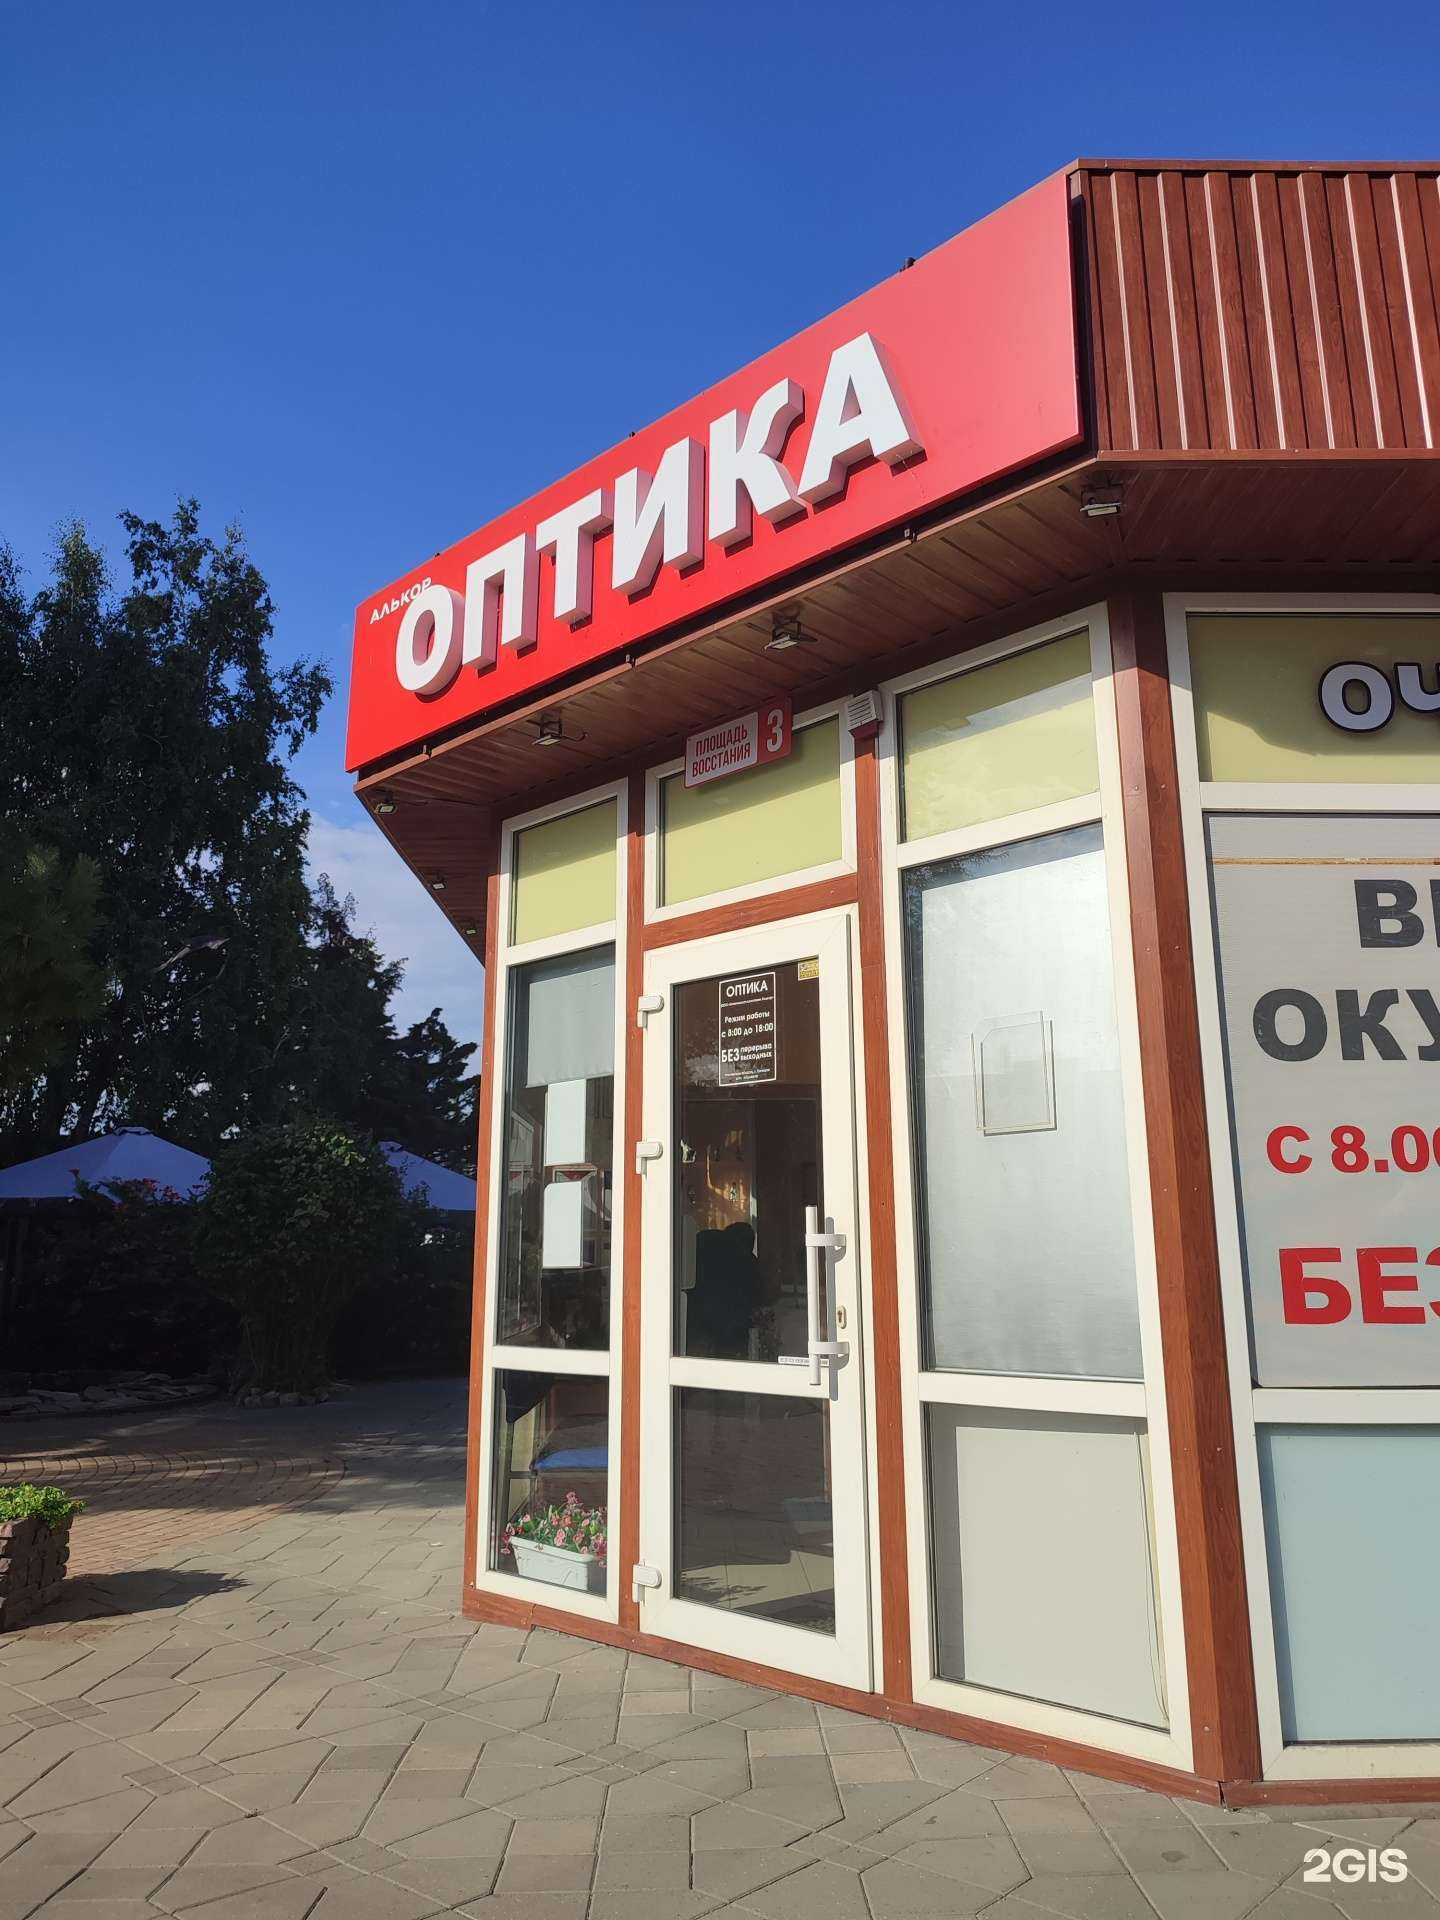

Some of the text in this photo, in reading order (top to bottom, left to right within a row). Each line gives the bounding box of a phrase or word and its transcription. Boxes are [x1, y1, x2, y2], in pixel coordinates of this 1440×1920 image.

[395, 331, 925, 695] ОПТИКА
[369, 576, 432, 625] АЛЬКОР
[695, 724, 748, 757] ПЛОЩАДЬ
[766, 708, 784, 752] 3
[692, 743, 751, 777] ВОССТАНИЯ
[1354, 879, 1440, 949] В
[726, 980, 768, 998] ОПТИКА
[725, 1011, 770, 1023] Режим работы
[728, 1027, 742, 1037] 8:00
[743, 1026, 753, 1036] до
[755, 1022, 774, 1033] 18:00
[721, 1043, 772, 1063] БЕЗ перерыва
[740, 1051, 772, 1061] выходных
[1266, 1125, 1440, 1174] С 8.0
[1278, 1247, 1440, 1325] БЕ
